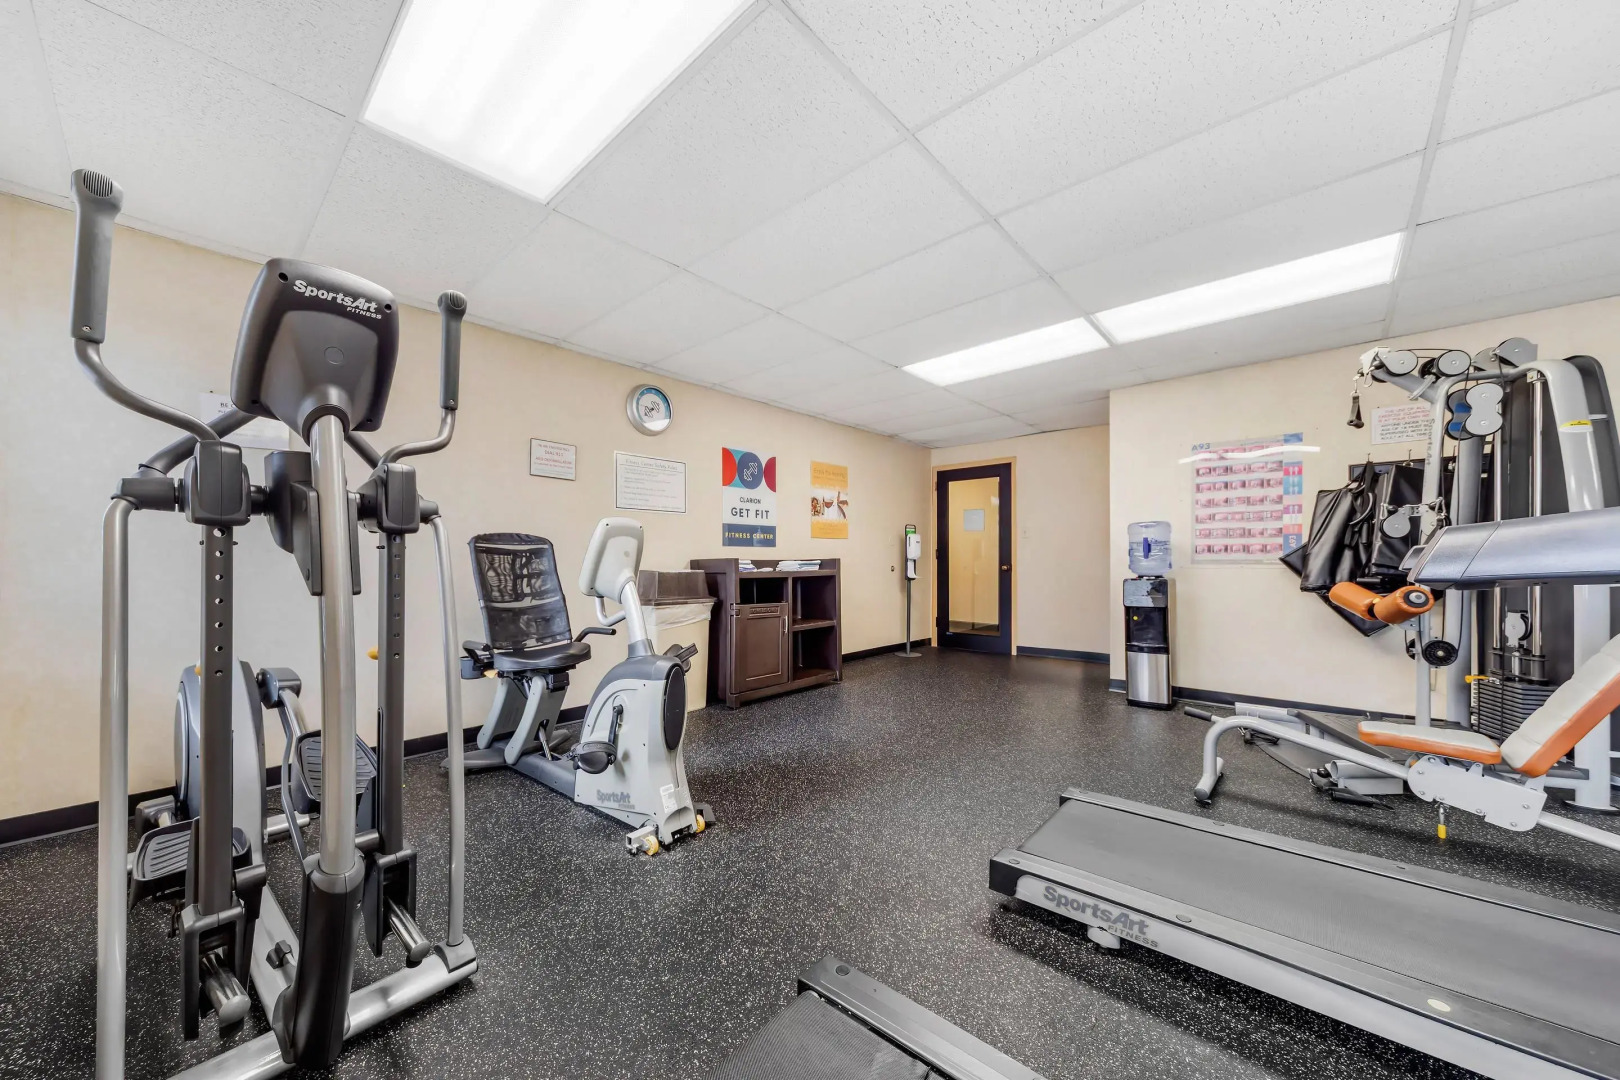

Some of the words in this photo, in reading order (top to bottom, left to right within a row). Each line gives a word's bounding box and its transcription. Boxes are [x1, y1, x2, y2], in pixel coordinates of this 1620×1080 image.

[293, 279, 378, 312] SportsArt
[346, 306, 382, 320] FITNESS
[1192, 443, 1211, 452] A93
[739, 496, 761, 505] CLARION
[730, 507, 750, 518] GET
[755, 509, 770, 520] FIT
[596, 789, 631, 804] SportsArt
[1043, 885, 1149, 935] SportsArt
[1108, 924, 1159, 948] FITNESS
